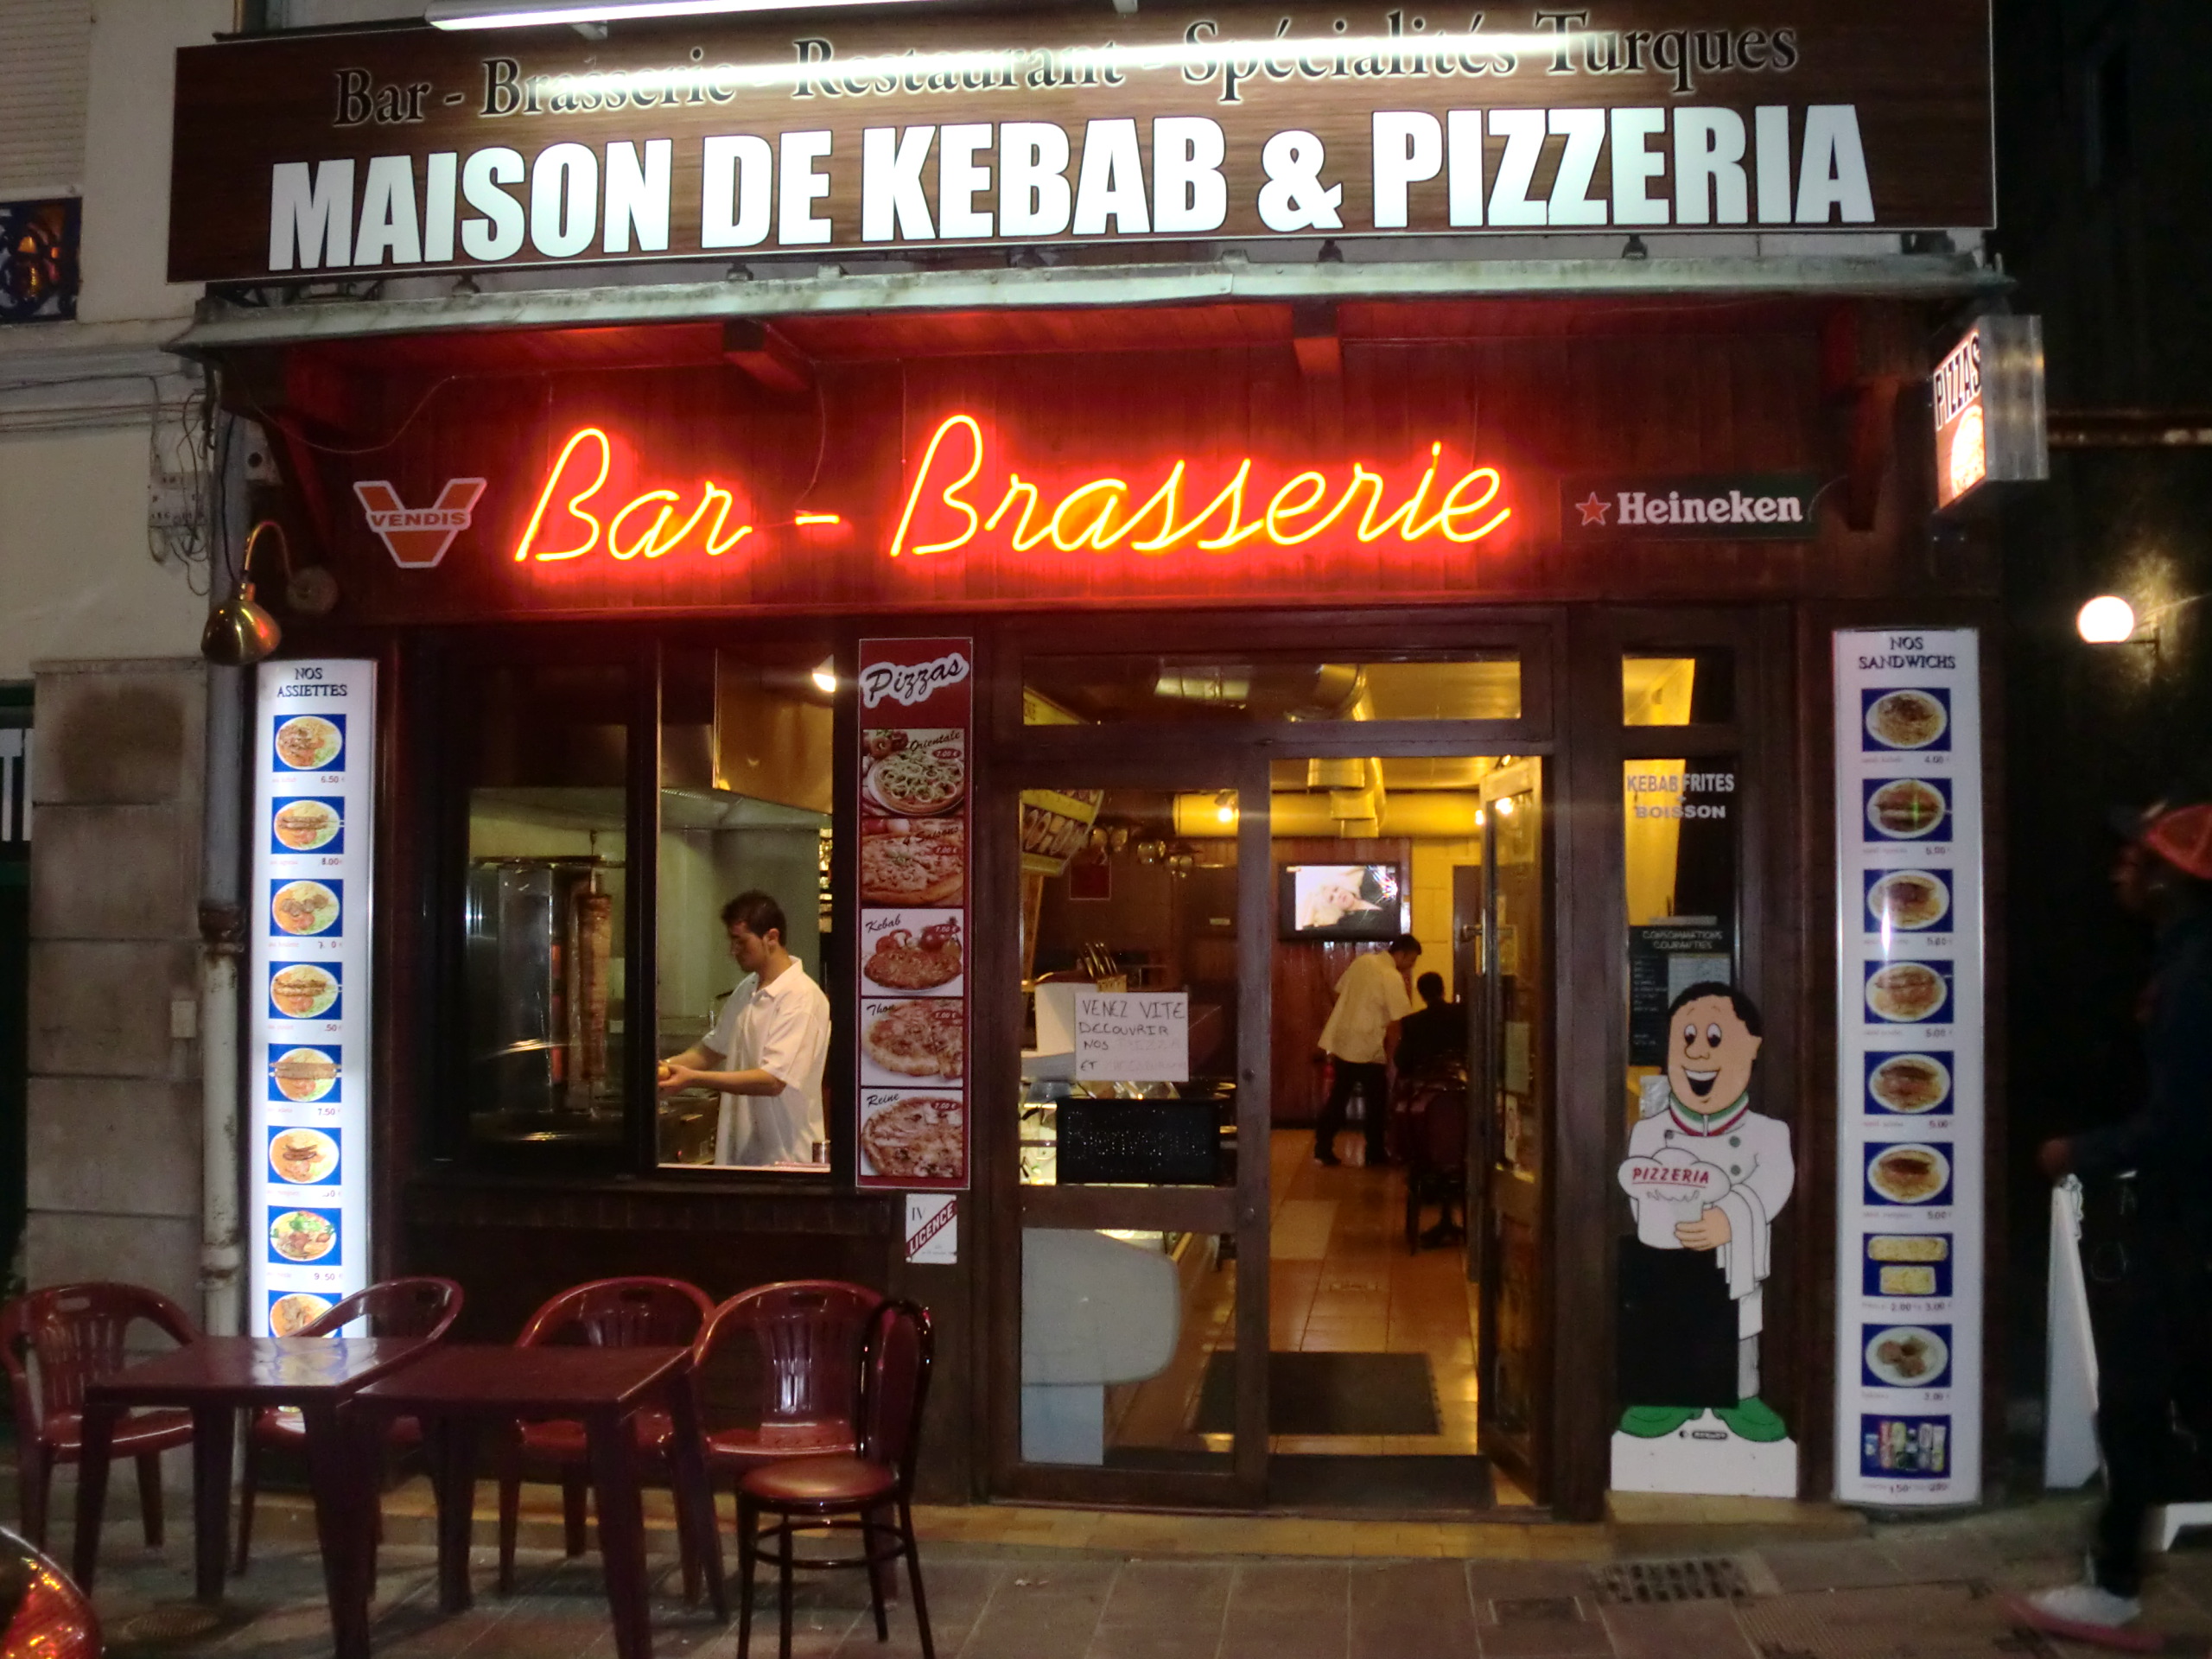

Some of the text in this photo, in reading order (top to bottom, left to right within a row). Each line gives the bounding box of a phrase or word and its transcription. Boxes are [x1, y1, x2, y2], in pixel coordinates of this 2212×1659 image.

[333, 67, 430, 127] Bar
[478, 47, 736, 117] Brasserie
[791, 37, 1126, 98] Restaurant
[1181, 10, 1518, 104] Spécialités
[1534, 10, 1799, 94] Turques
[268, 104, 1876, 272] MAISON DE KEBAB & PIZZERIA
[1933, 332, 1982, 432] PIZZAS
[515, 427, 753, 563] Bar
[889, 413, 1511, 557] Brasserie
[1617, 489, 1805, 526] Heineken
[367, 511, 467, 528] VENDIS
[1890, 637, 1924, 650] NOS
[1859, 656, 1956, 670] SANDWICHS
[295, 667, 322, 680] NOS
[866, 658, 963, 702] Pizzas
[276, 683, 347, 697] ASSIETTES
[1626, 773, 1735, 792] KEBAB FRITES
[1636, 805, 1726, 819] BOISSON
[865, 913, 901, 933] Kebab
[1083, 1000, 1185, 1020] VENEZ VITE
[1078, 1021, 1169, 1036] DECOUVRIR
[1084, 1039, 1109, 1050] NOS
[1080, 1059, 1097, 1071] ET
[867, 1093, 899, 1108] Reine
[1632, 1167, 1709, 1184] PIZZERIA
[910, 1202, 954, 1255] LICENCE
